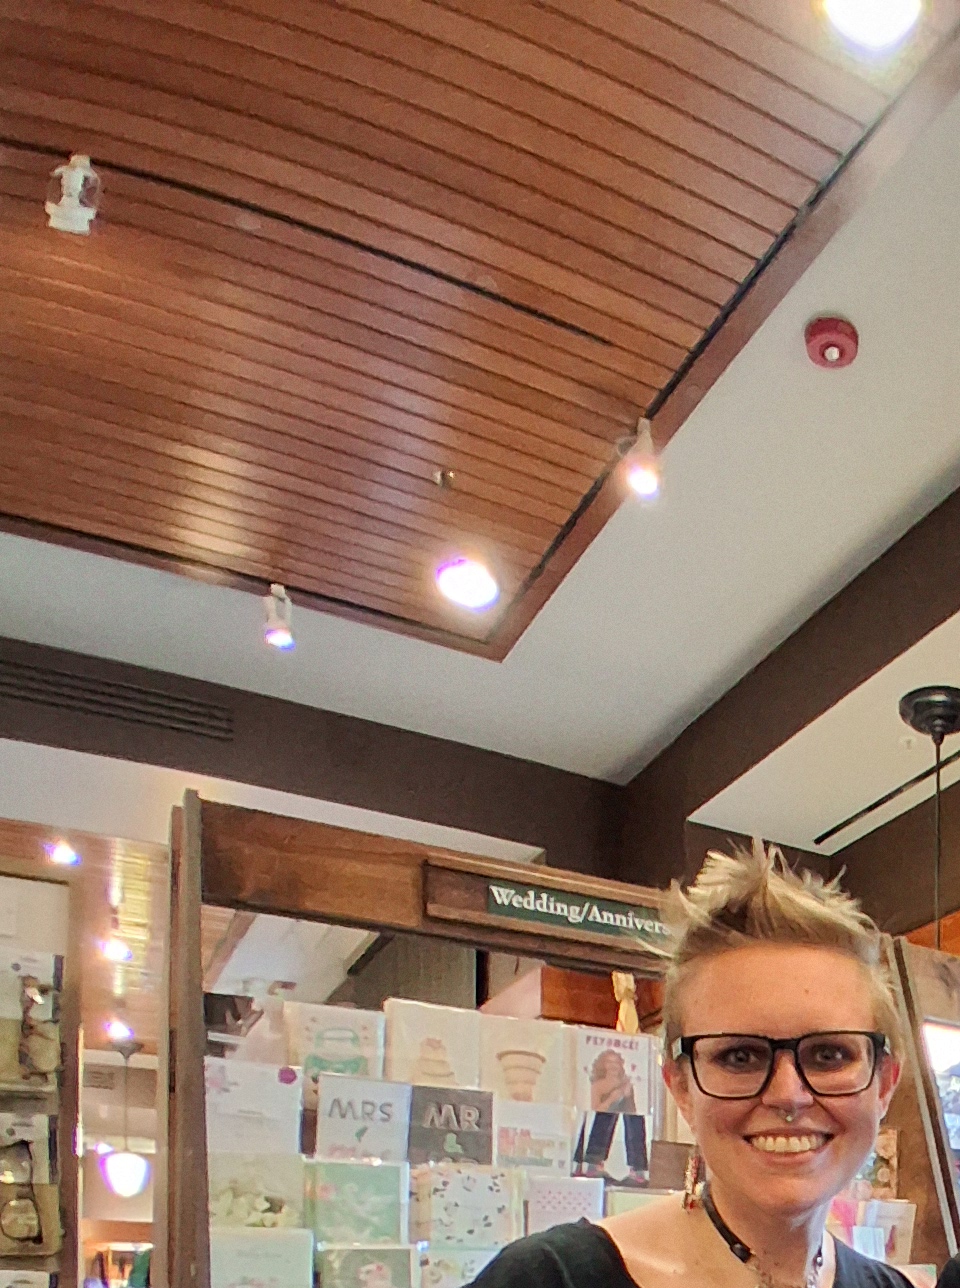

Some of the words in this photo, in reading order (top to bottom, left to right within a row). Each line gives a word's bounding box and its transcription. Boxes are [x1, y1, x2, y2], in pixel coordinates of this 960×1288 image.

[489, 884, 671, 935] Wedding/Annivers
[328, 1097, 394, 1123] MRS
[421, 1101, 481, 1132] MR
